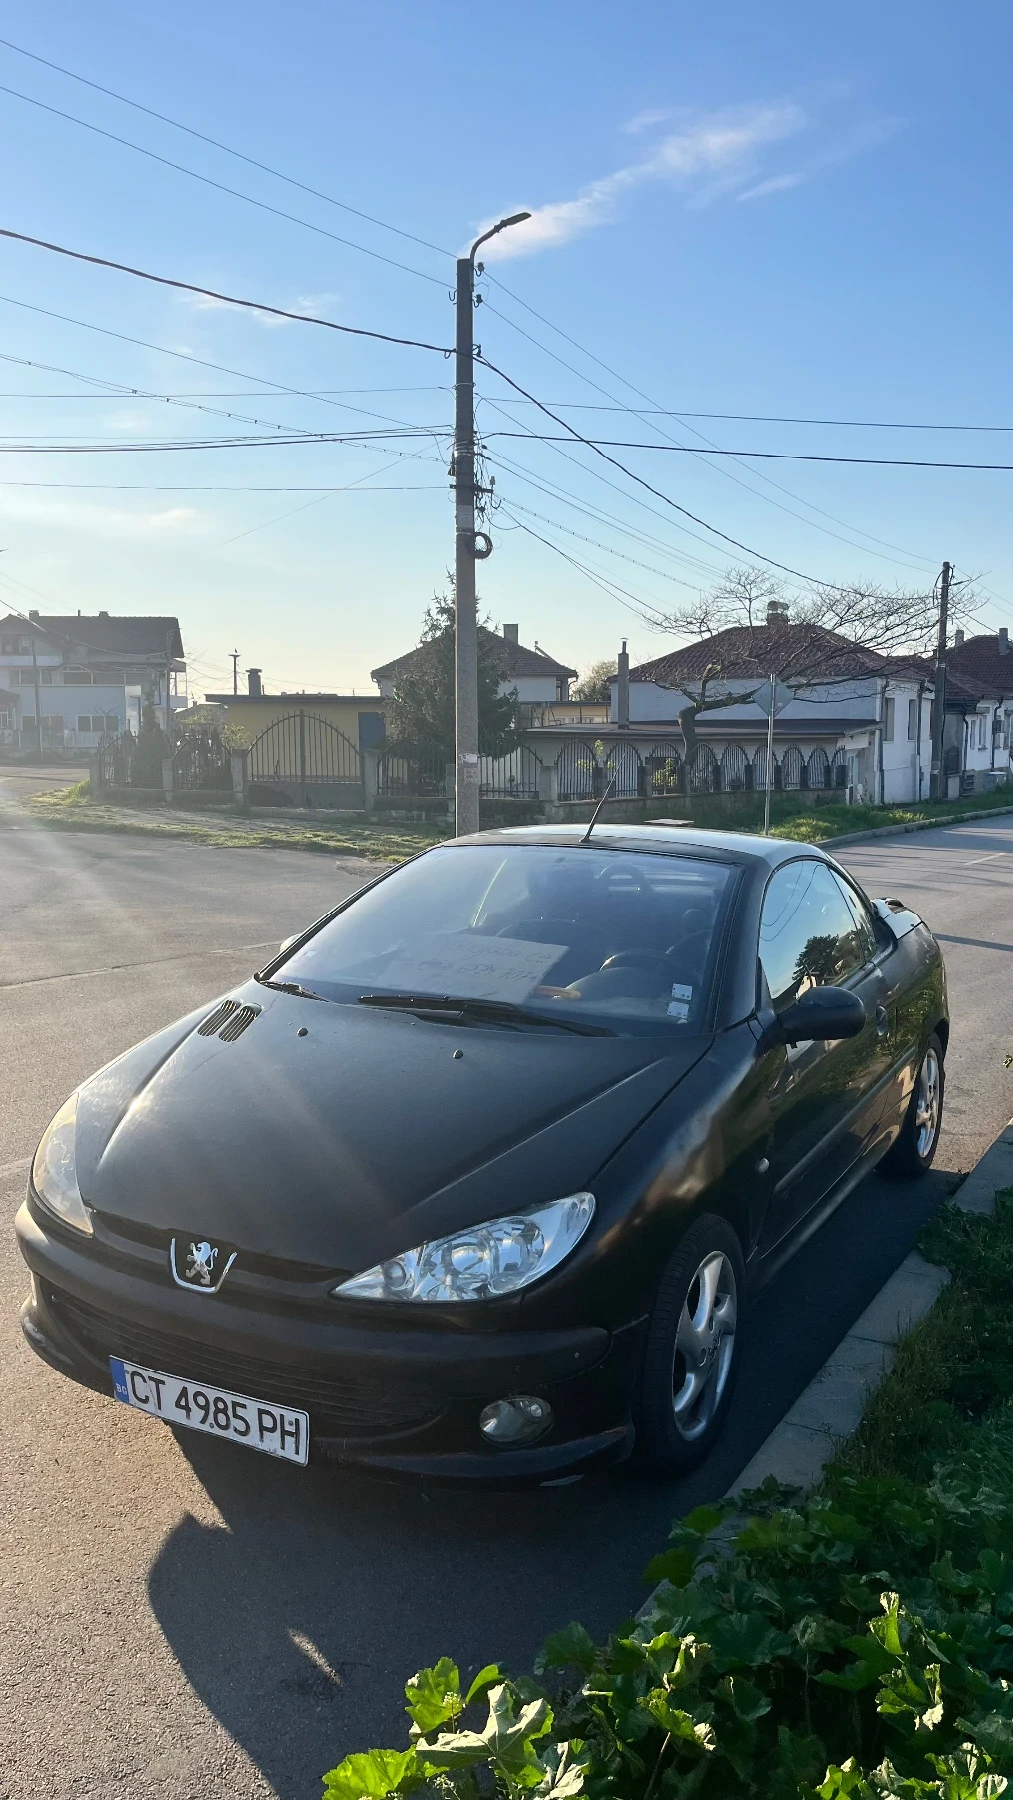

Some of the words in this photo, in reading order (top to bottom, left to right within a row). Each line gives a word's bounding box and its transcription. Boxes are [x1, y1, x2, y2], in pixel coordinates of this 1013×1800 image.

[115, 1382, 128, 1396] BG
[130, 1370, 166, 1411] CT
[174, 1386, 251, 1437] 4985
[257, 1407, 300, 1456] PH
